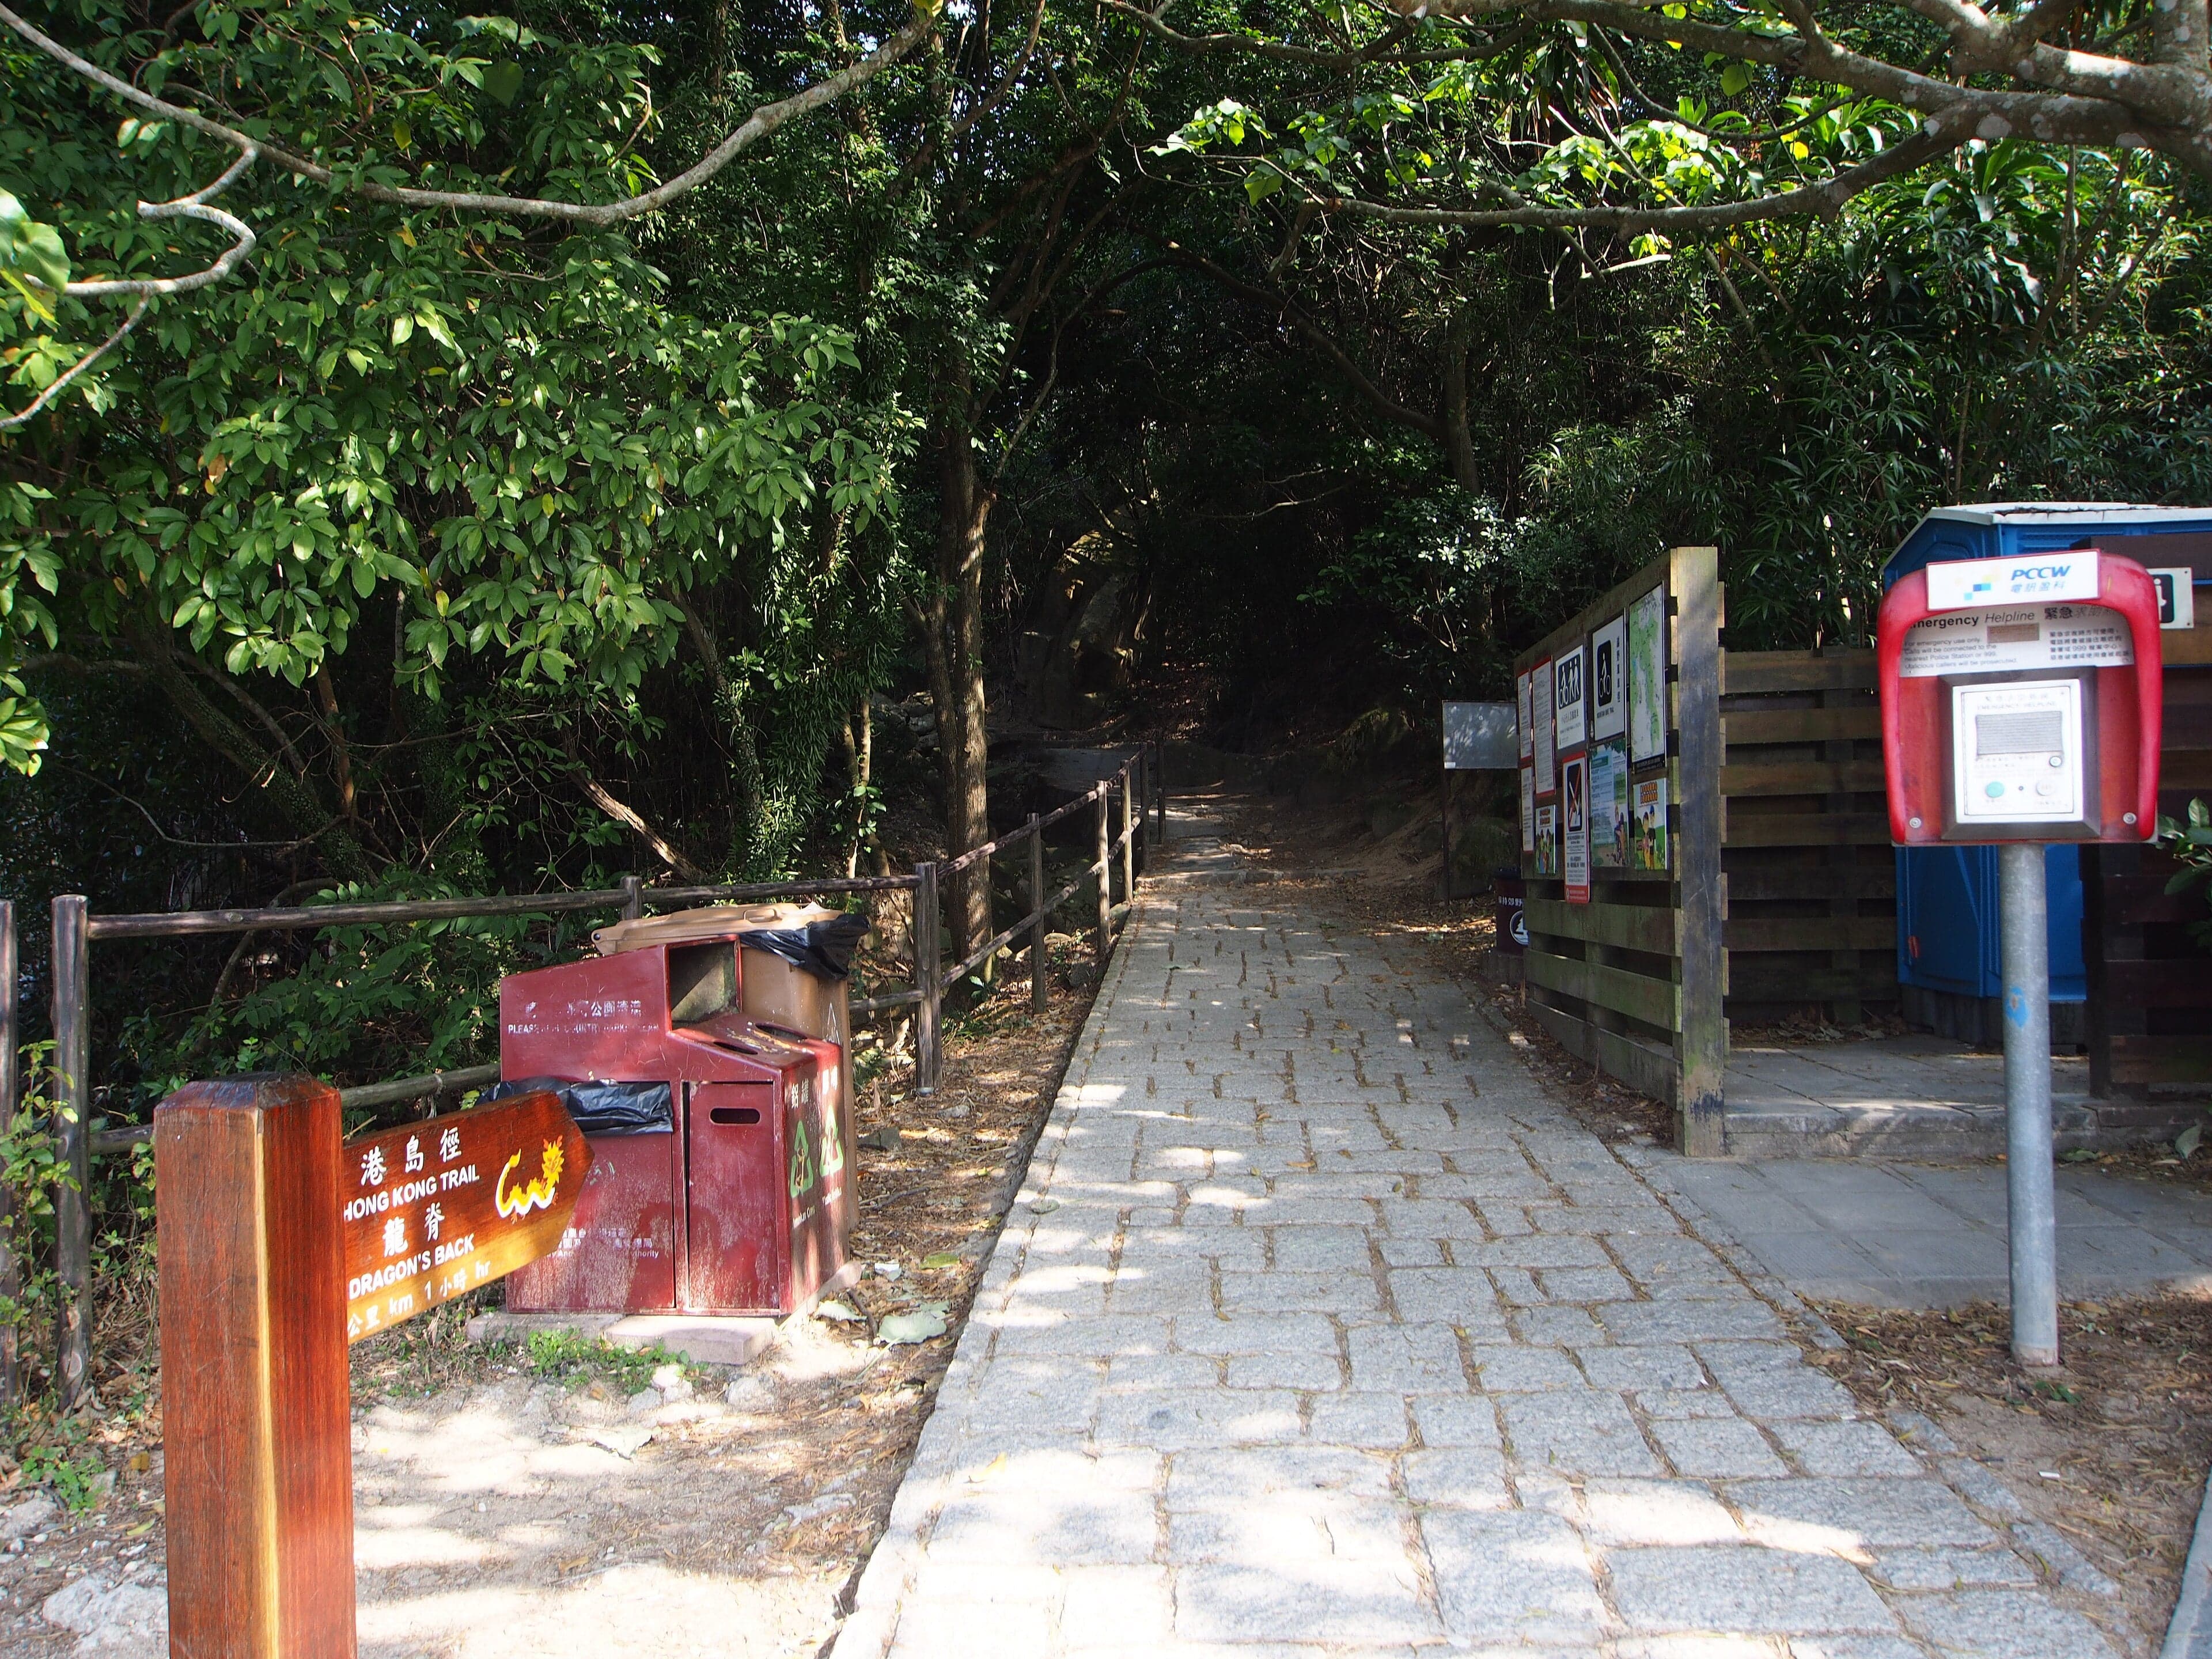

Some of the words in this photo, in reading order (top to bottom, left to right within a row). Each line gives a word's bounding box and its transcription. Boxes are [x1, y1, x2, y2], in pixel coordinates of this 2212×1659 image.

[2010, 565, 2071, 581] PCCW
[1910, 616, 1979, 628] mergency
[1984, 611, 2035, 623] Helpline
[1916, 639, 1951, 647] emergency
[361, 1127, 462, 1185] 港島徑
[343, 1191, 389, 1222] HONG
[392, 1176, 437, 1207] KONG
[440, 1164, 479, 1191] TRAIL
[382, 1202, 445, 1257] 龍脊
[349, 1251, 431, 1300] DRAGON'S
[435, 1234, 475, 1266] BACK
[347, 1305, 380, 1338] 公里
[389, 1293, 413, 1317] km
[424, 1280, 432, 1301] 1
[440, 1268, 468, 1298] 小時
[475, 1260, 492, 1280] hr
